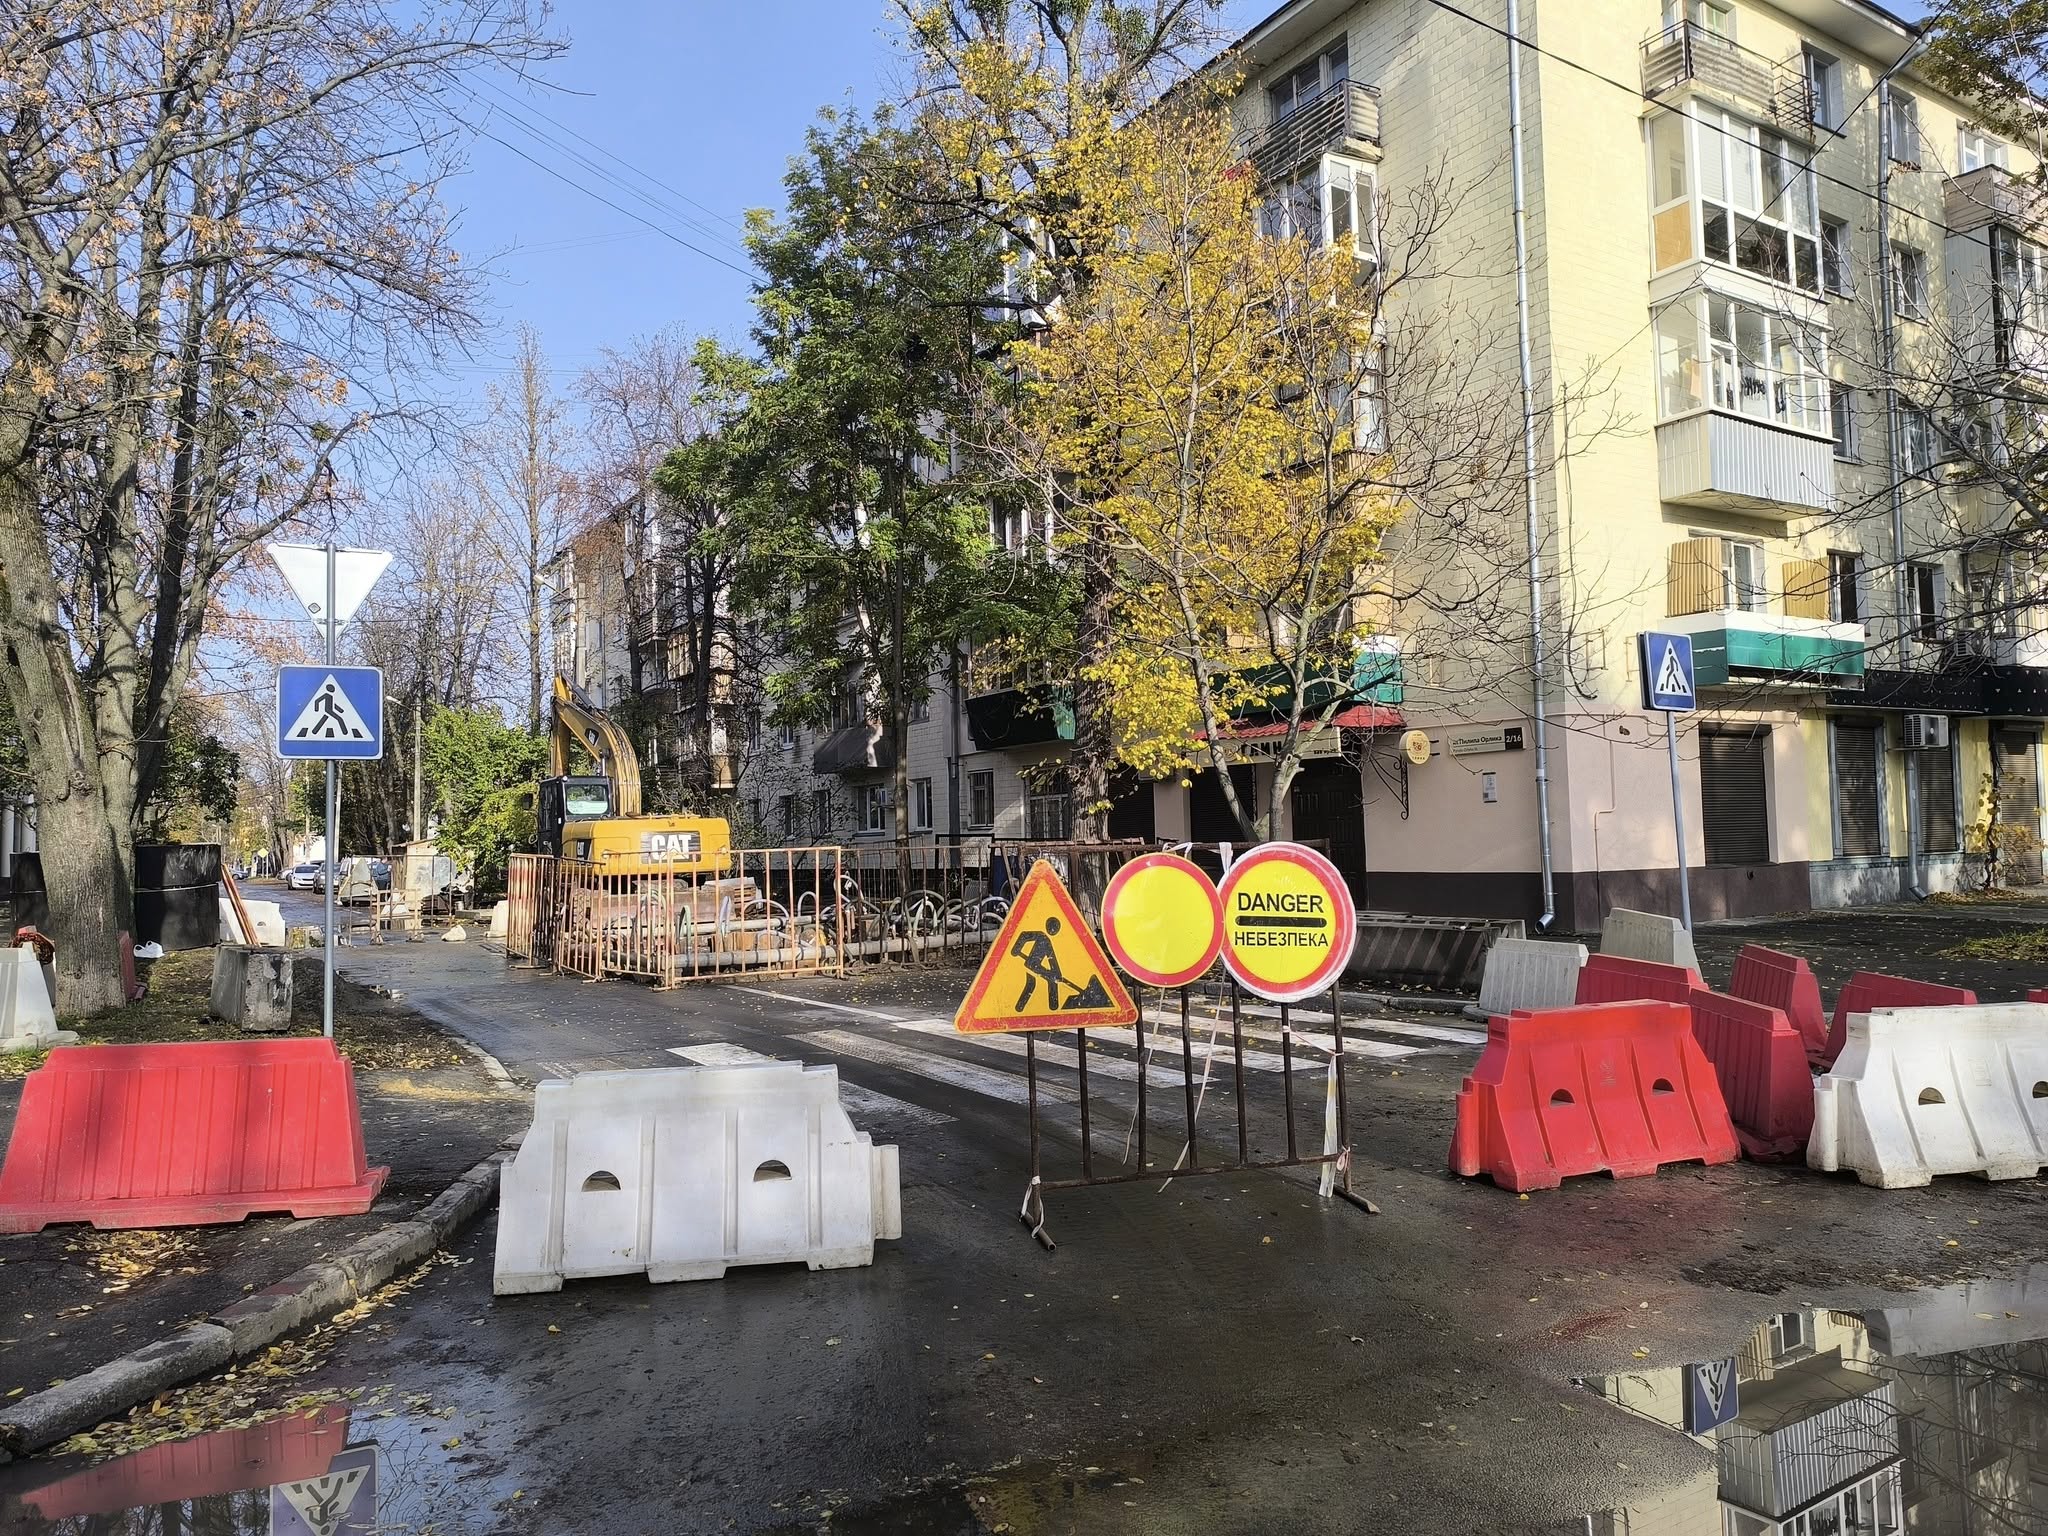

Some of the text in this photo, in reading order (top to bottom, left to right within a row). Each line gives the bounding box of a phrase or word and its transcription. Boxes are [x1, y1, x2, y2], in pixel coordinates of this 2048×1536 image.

[1505, 735, 1522, 743] 2/16
[651, 834, 692, 861] CAT
[1237, 892, 1324, 913] DANGER
[1234, 931, 1329, 947] НЕБЕЗПЕКА
